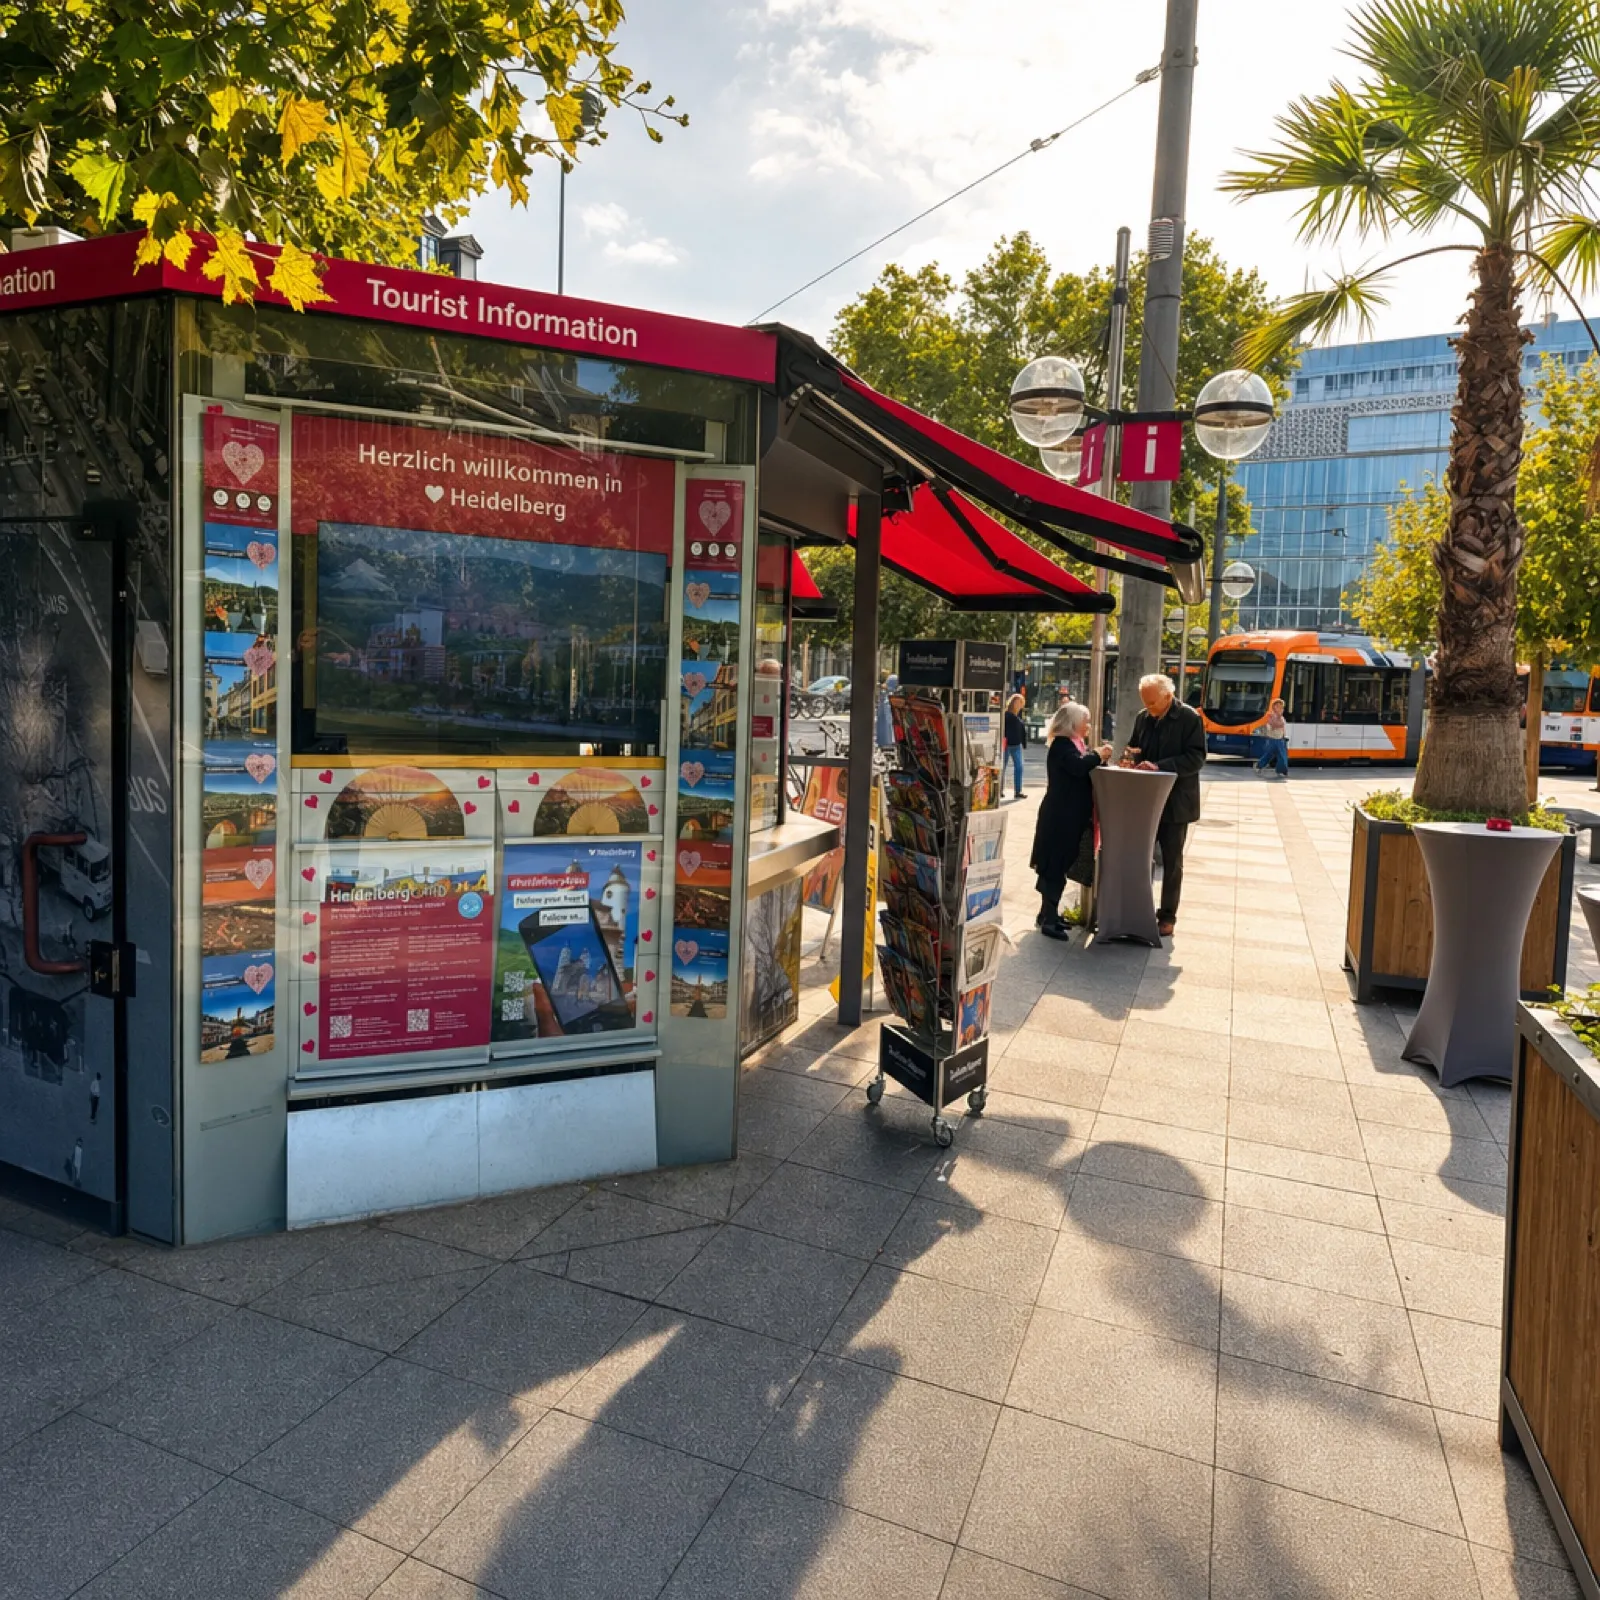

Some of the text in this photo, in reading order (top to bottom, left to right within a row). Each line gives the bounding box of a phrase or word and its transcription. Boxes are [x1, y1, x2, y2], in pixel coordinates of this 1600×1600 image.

[0, 267, 56, 294] ation
[366, 278, 638, 348] Tourist Information
[358, 443, 622, 493] Herzlich willkommen in
[1144, 425, 1158, 474] i
[450, 488, 567, 522] Heidelberg
[815, 798, 845, 821] EIS
